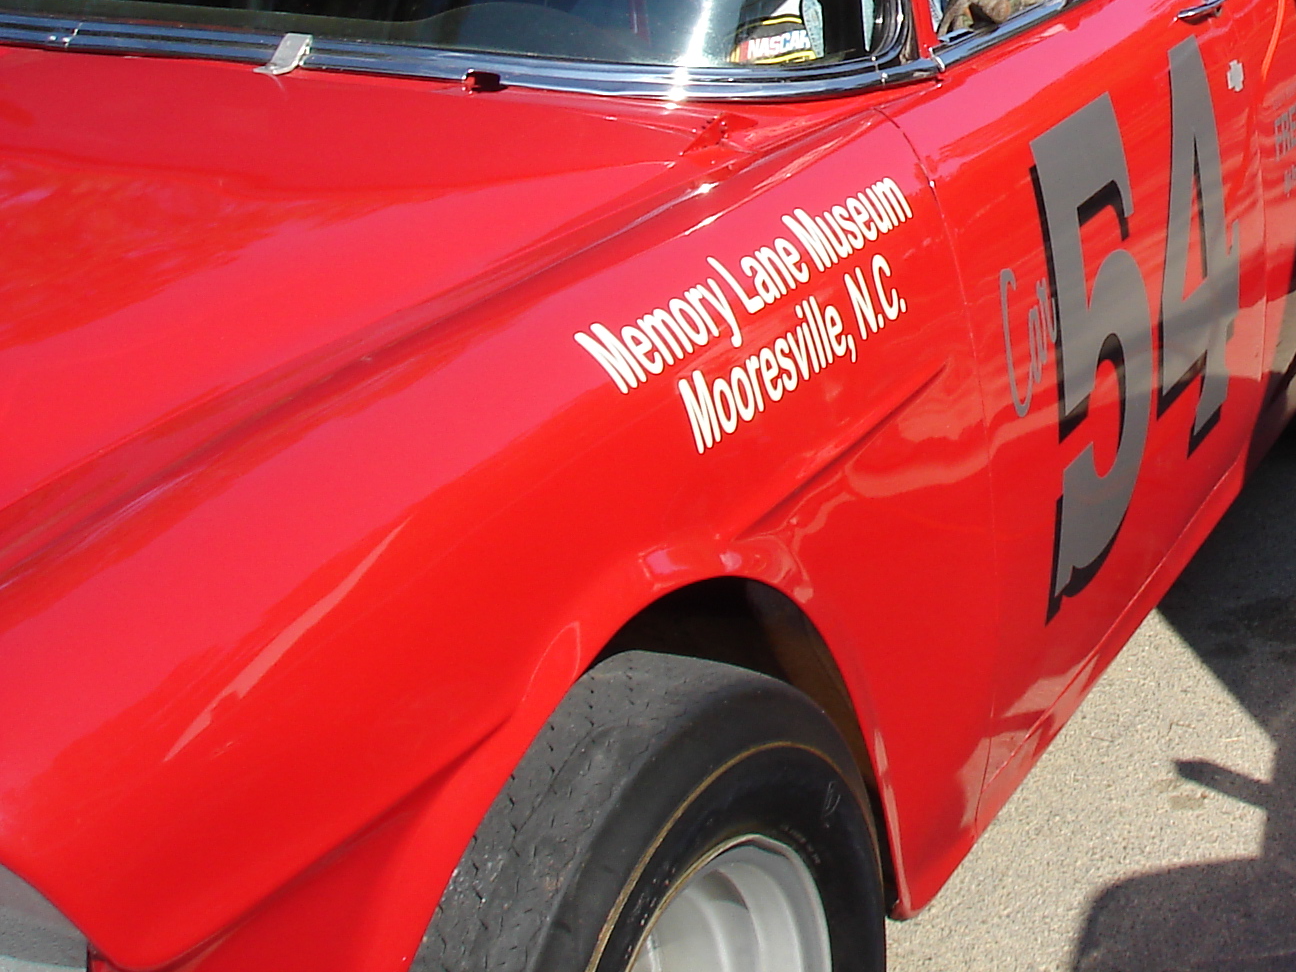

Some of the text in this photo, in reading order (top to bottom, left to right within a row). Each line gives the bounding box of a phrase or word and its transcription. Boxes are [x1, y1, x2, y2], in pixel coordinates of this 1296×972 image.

[747, 30, 811, 60] NASCAR
[574, 177, 913, 395] Memory Lane Museum
[678, 253, 907, 454] Mooresville, N.C.
[1028, 34, 1241, 618] 54
